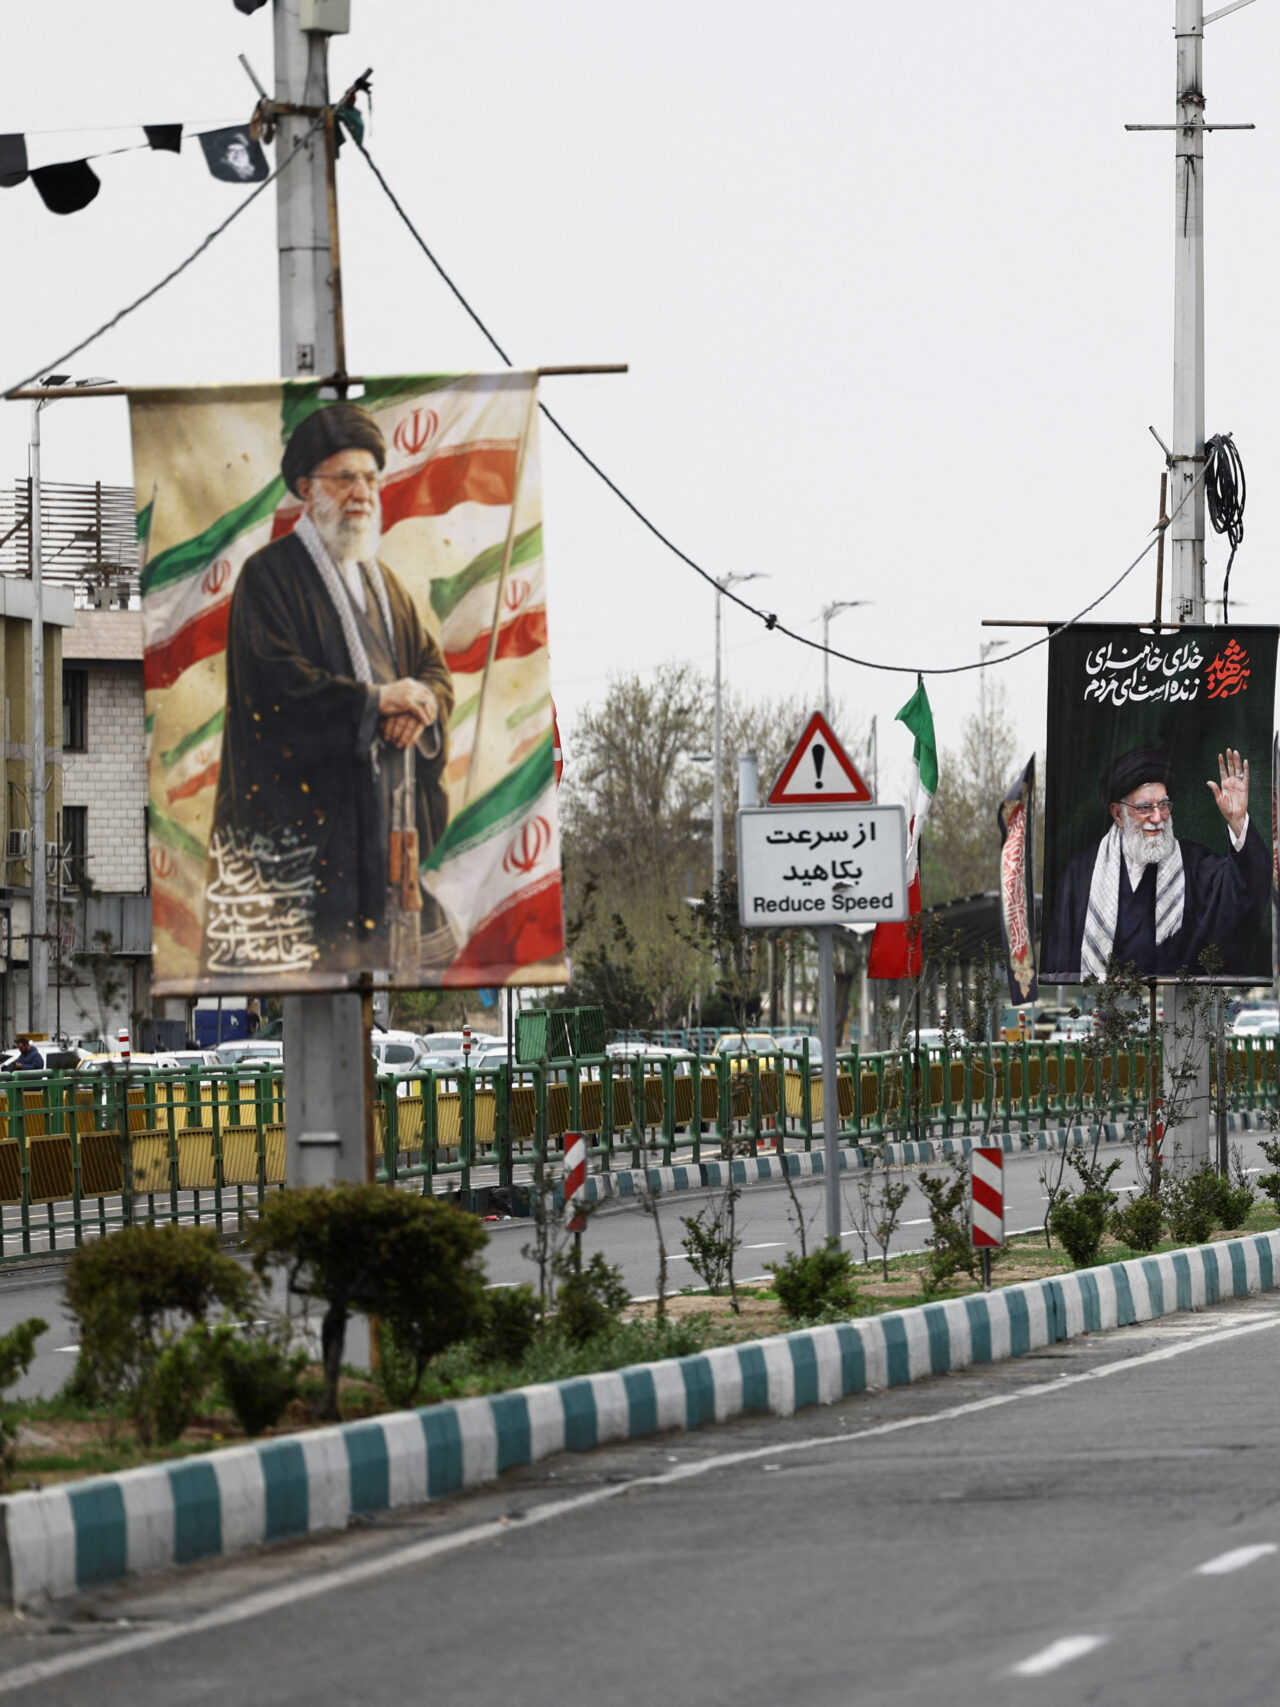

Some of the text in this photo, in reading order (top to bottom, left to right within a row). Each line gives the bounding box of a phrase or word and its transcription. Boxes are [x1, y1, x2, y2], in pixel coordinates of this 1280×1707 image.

[1170, 678, 1201, 703] زنده
[766, 822, 876, 850] از سرعت
[783, 860, 863, 887] بکاهید
[753, 893, 893, 913] Reduce Speed
